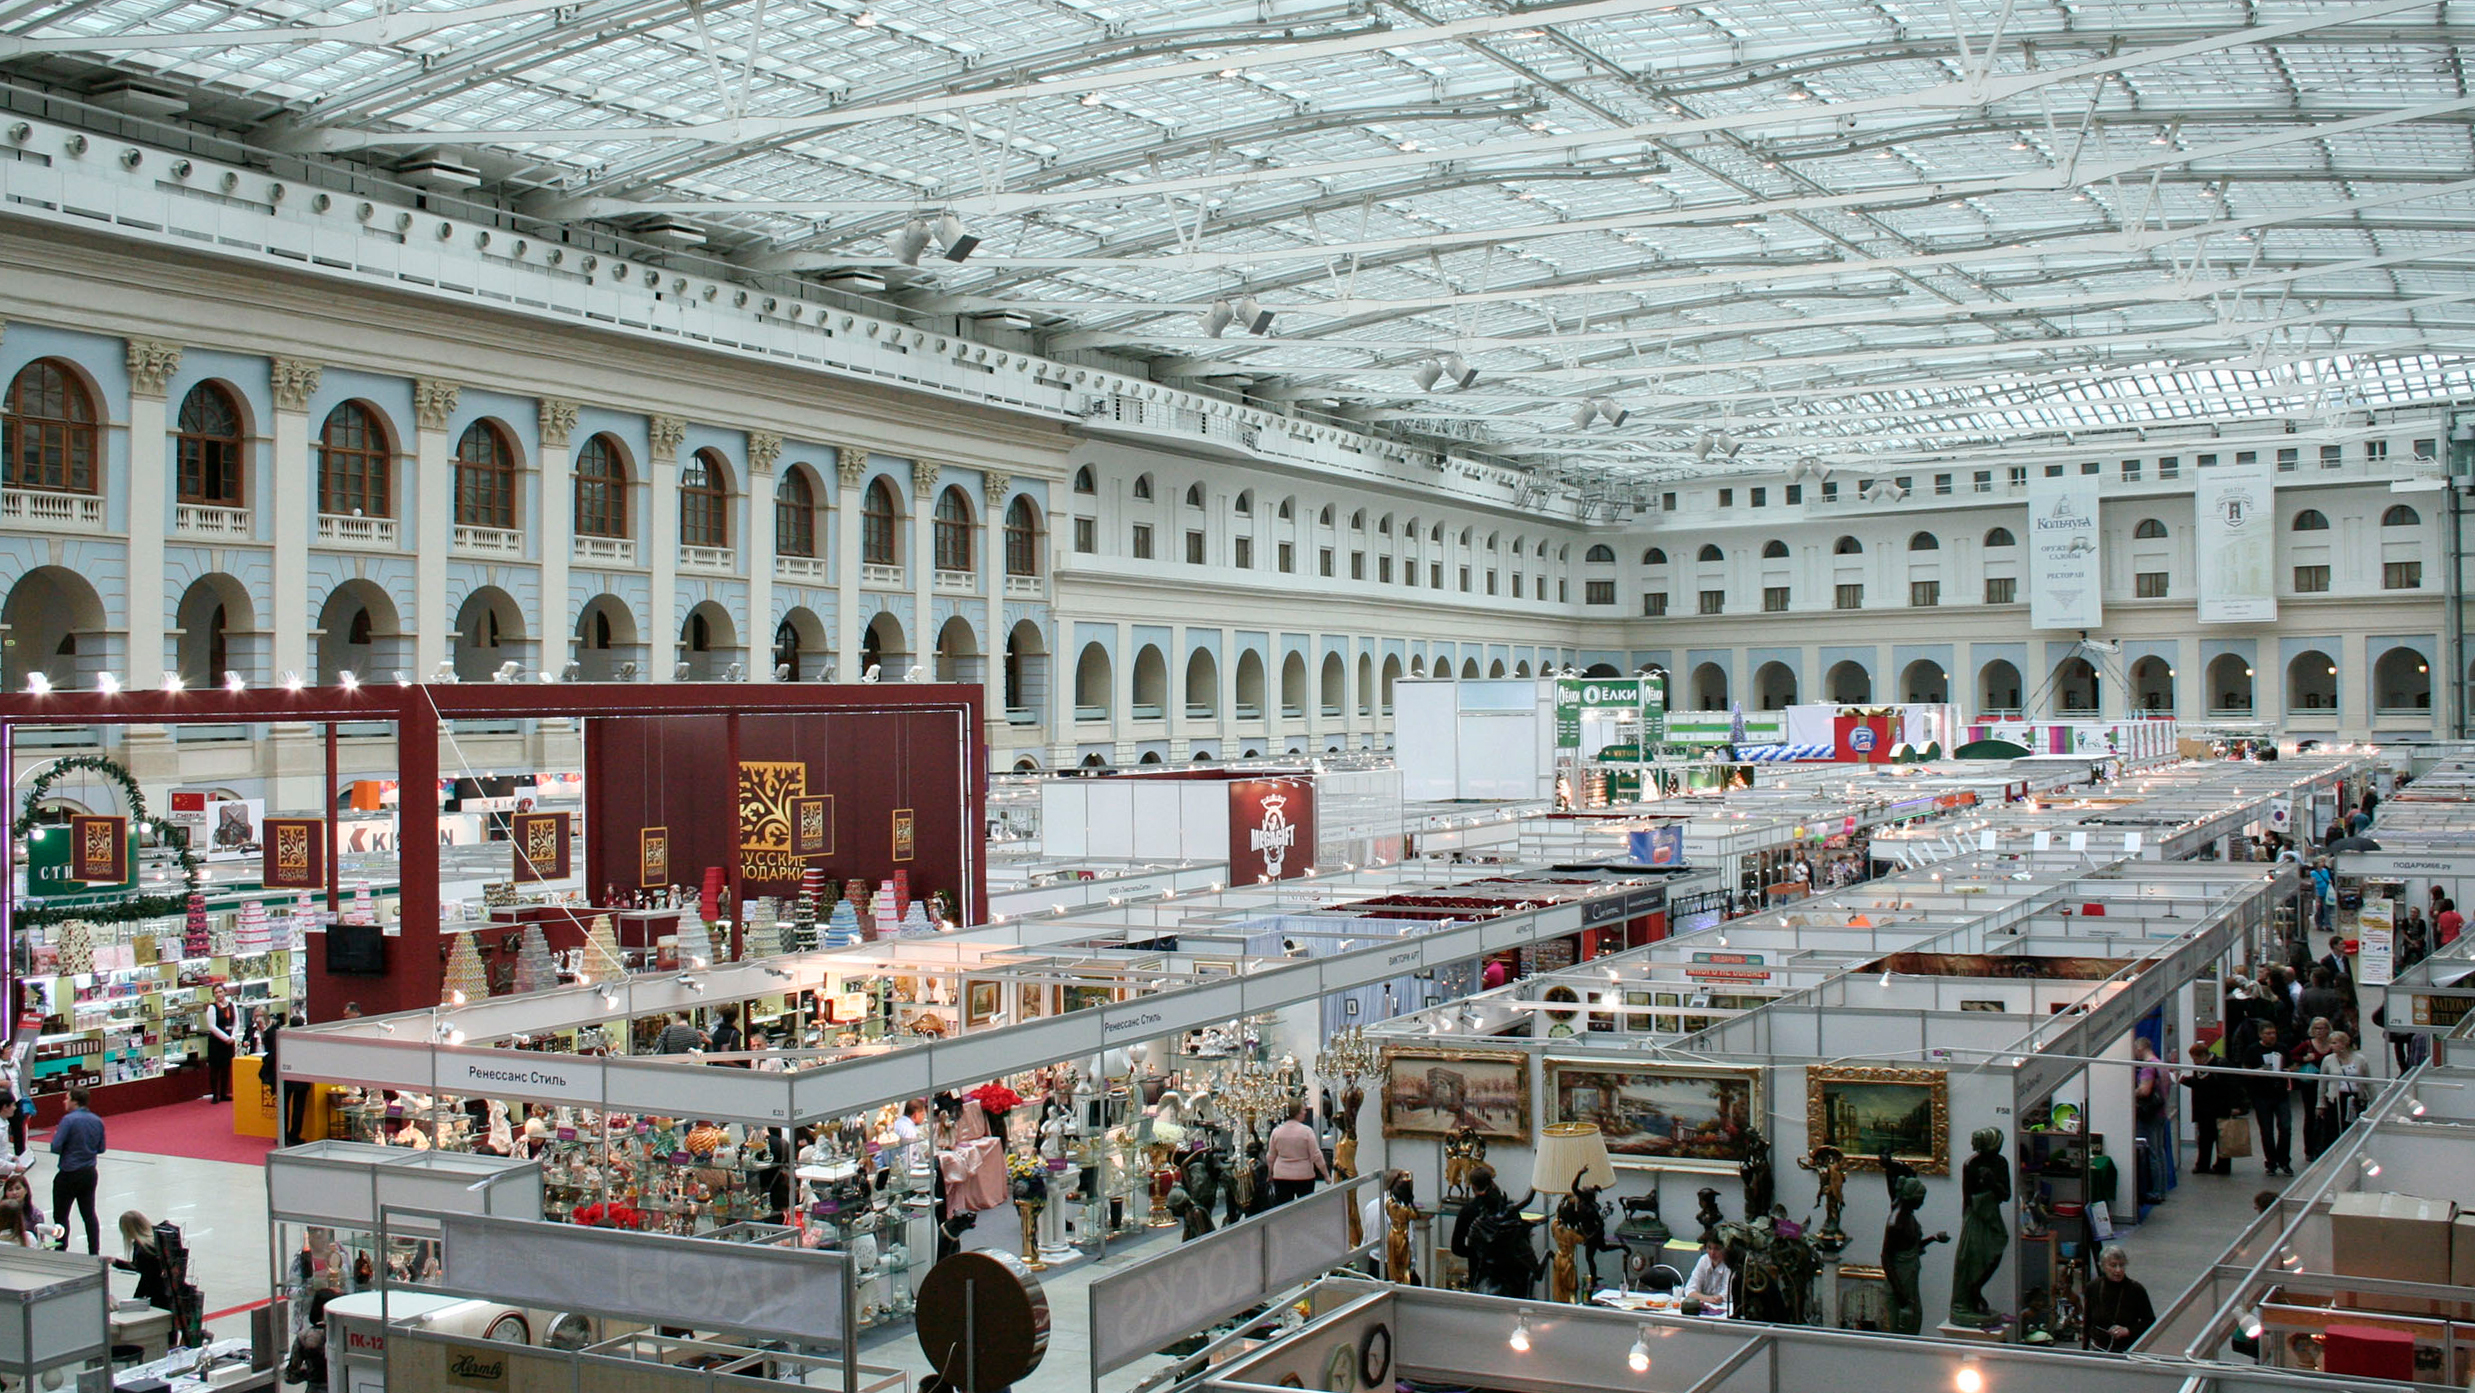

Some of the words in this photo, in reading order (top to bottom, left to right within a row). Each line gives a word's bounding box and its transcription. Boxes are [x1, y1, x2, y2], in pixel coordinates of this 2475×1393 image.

[1602, 687, 1637, 700] ЁЛКИ
[1251, 824, 1295, 851] MEGAGIFT
[1411, 950, 1420, 961] АРТ
[1104, 1017, 1140, 1034] Ренессанс
[1140, 1013, 1162, 1025] Стиль
[469, 1066, 528, 1083] Ренессанс
[531, 1072, 567, 1087] Стиль
[1996, 1106, 2011, 1115] F58
